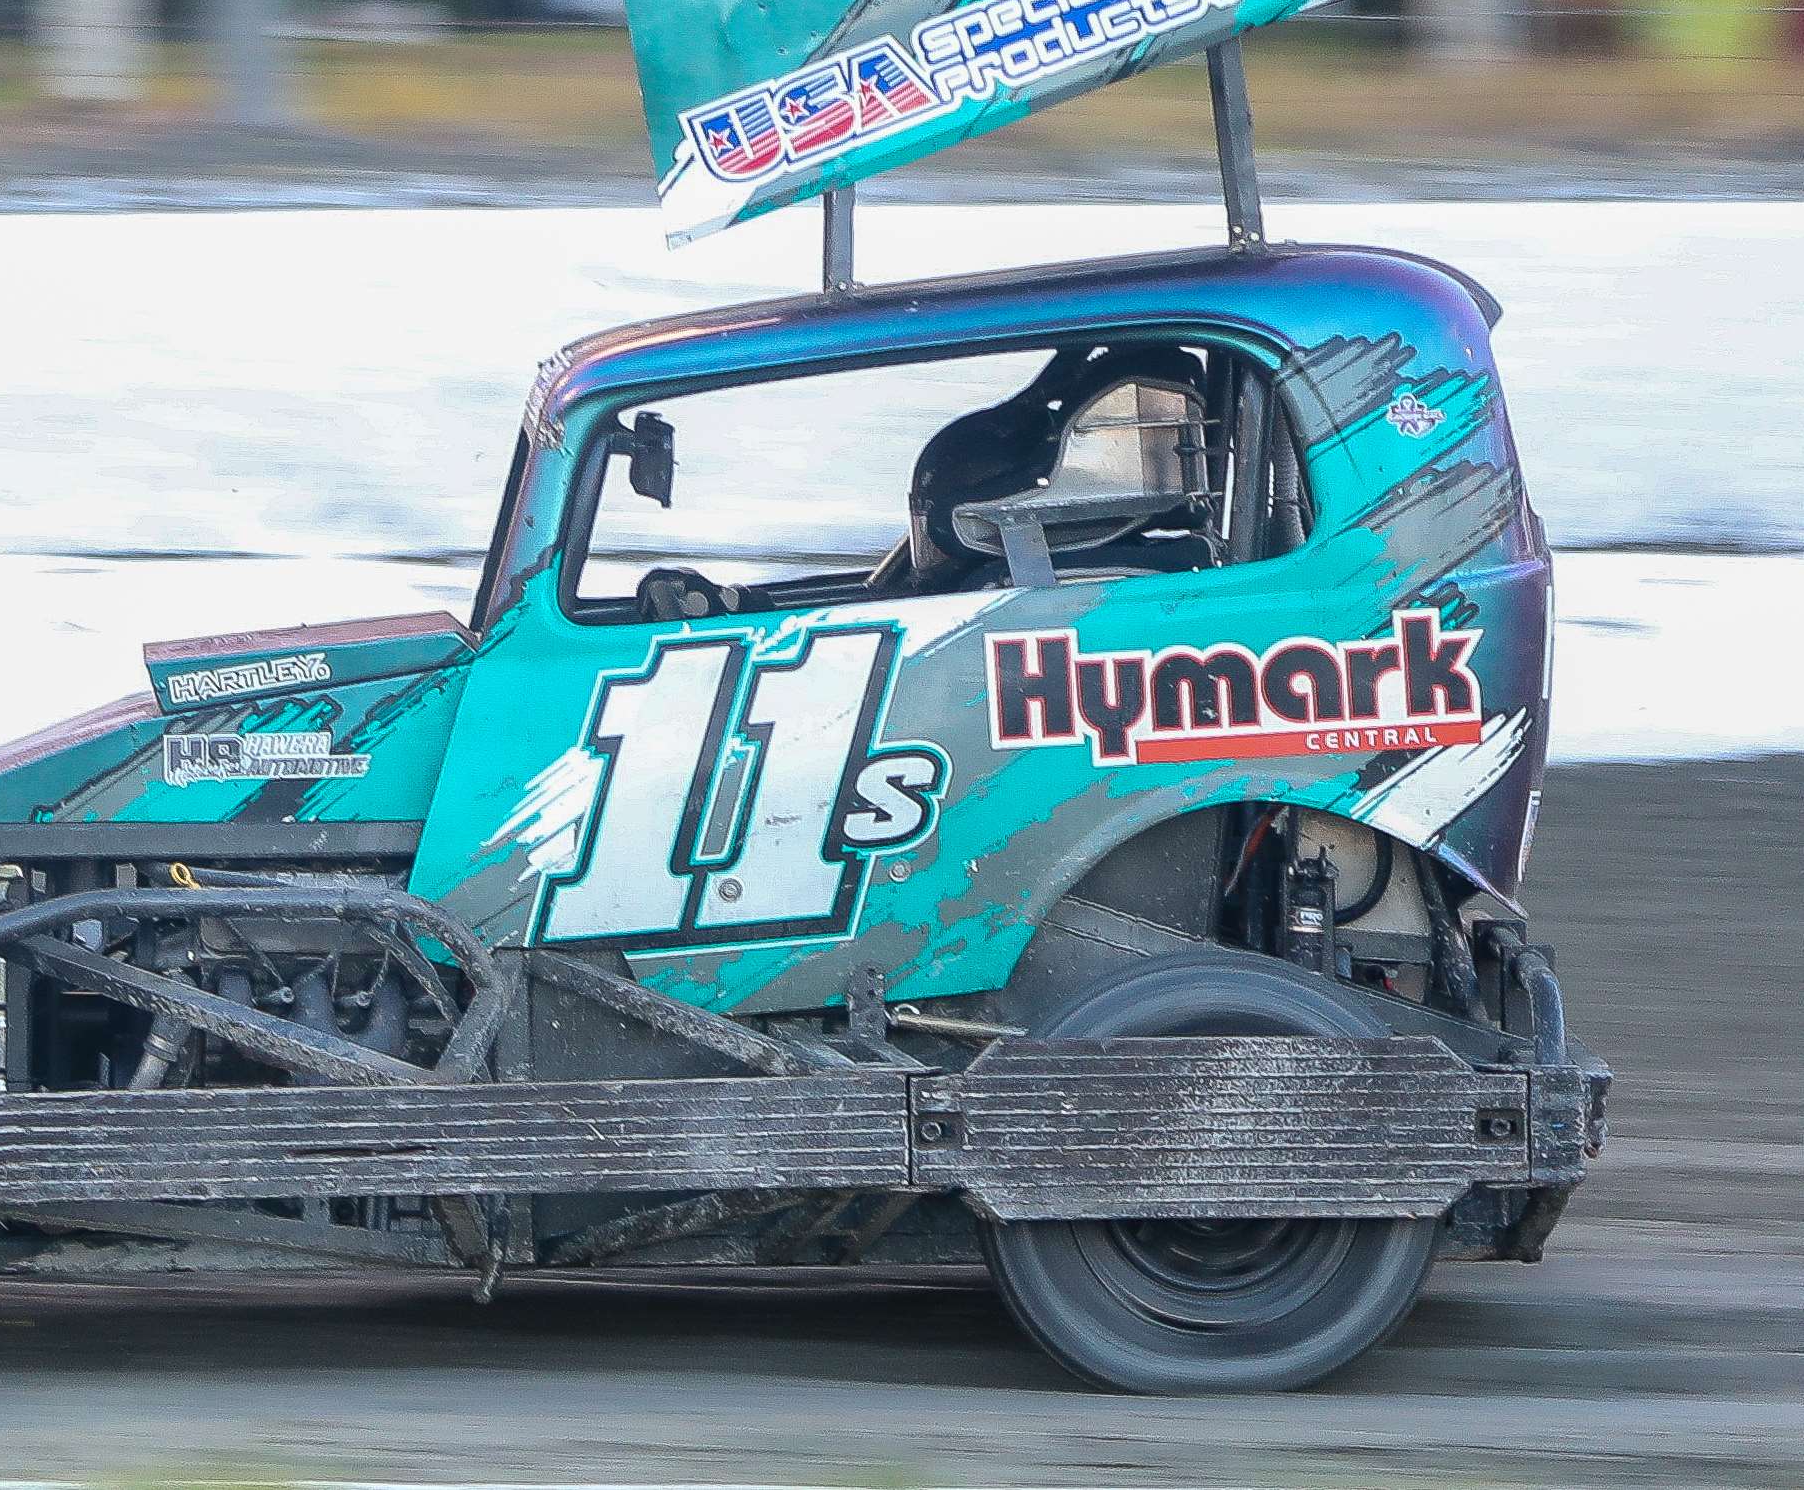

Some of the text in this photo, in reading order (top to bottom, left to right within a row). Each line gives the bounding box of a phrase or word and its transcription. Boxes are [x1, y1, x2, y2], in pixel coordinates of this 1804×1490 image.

[688, 40, 937, 186] USA
[991, 613, 1477, 761] Hymark
[1303, 726, 1438, 751] CENTRAL
